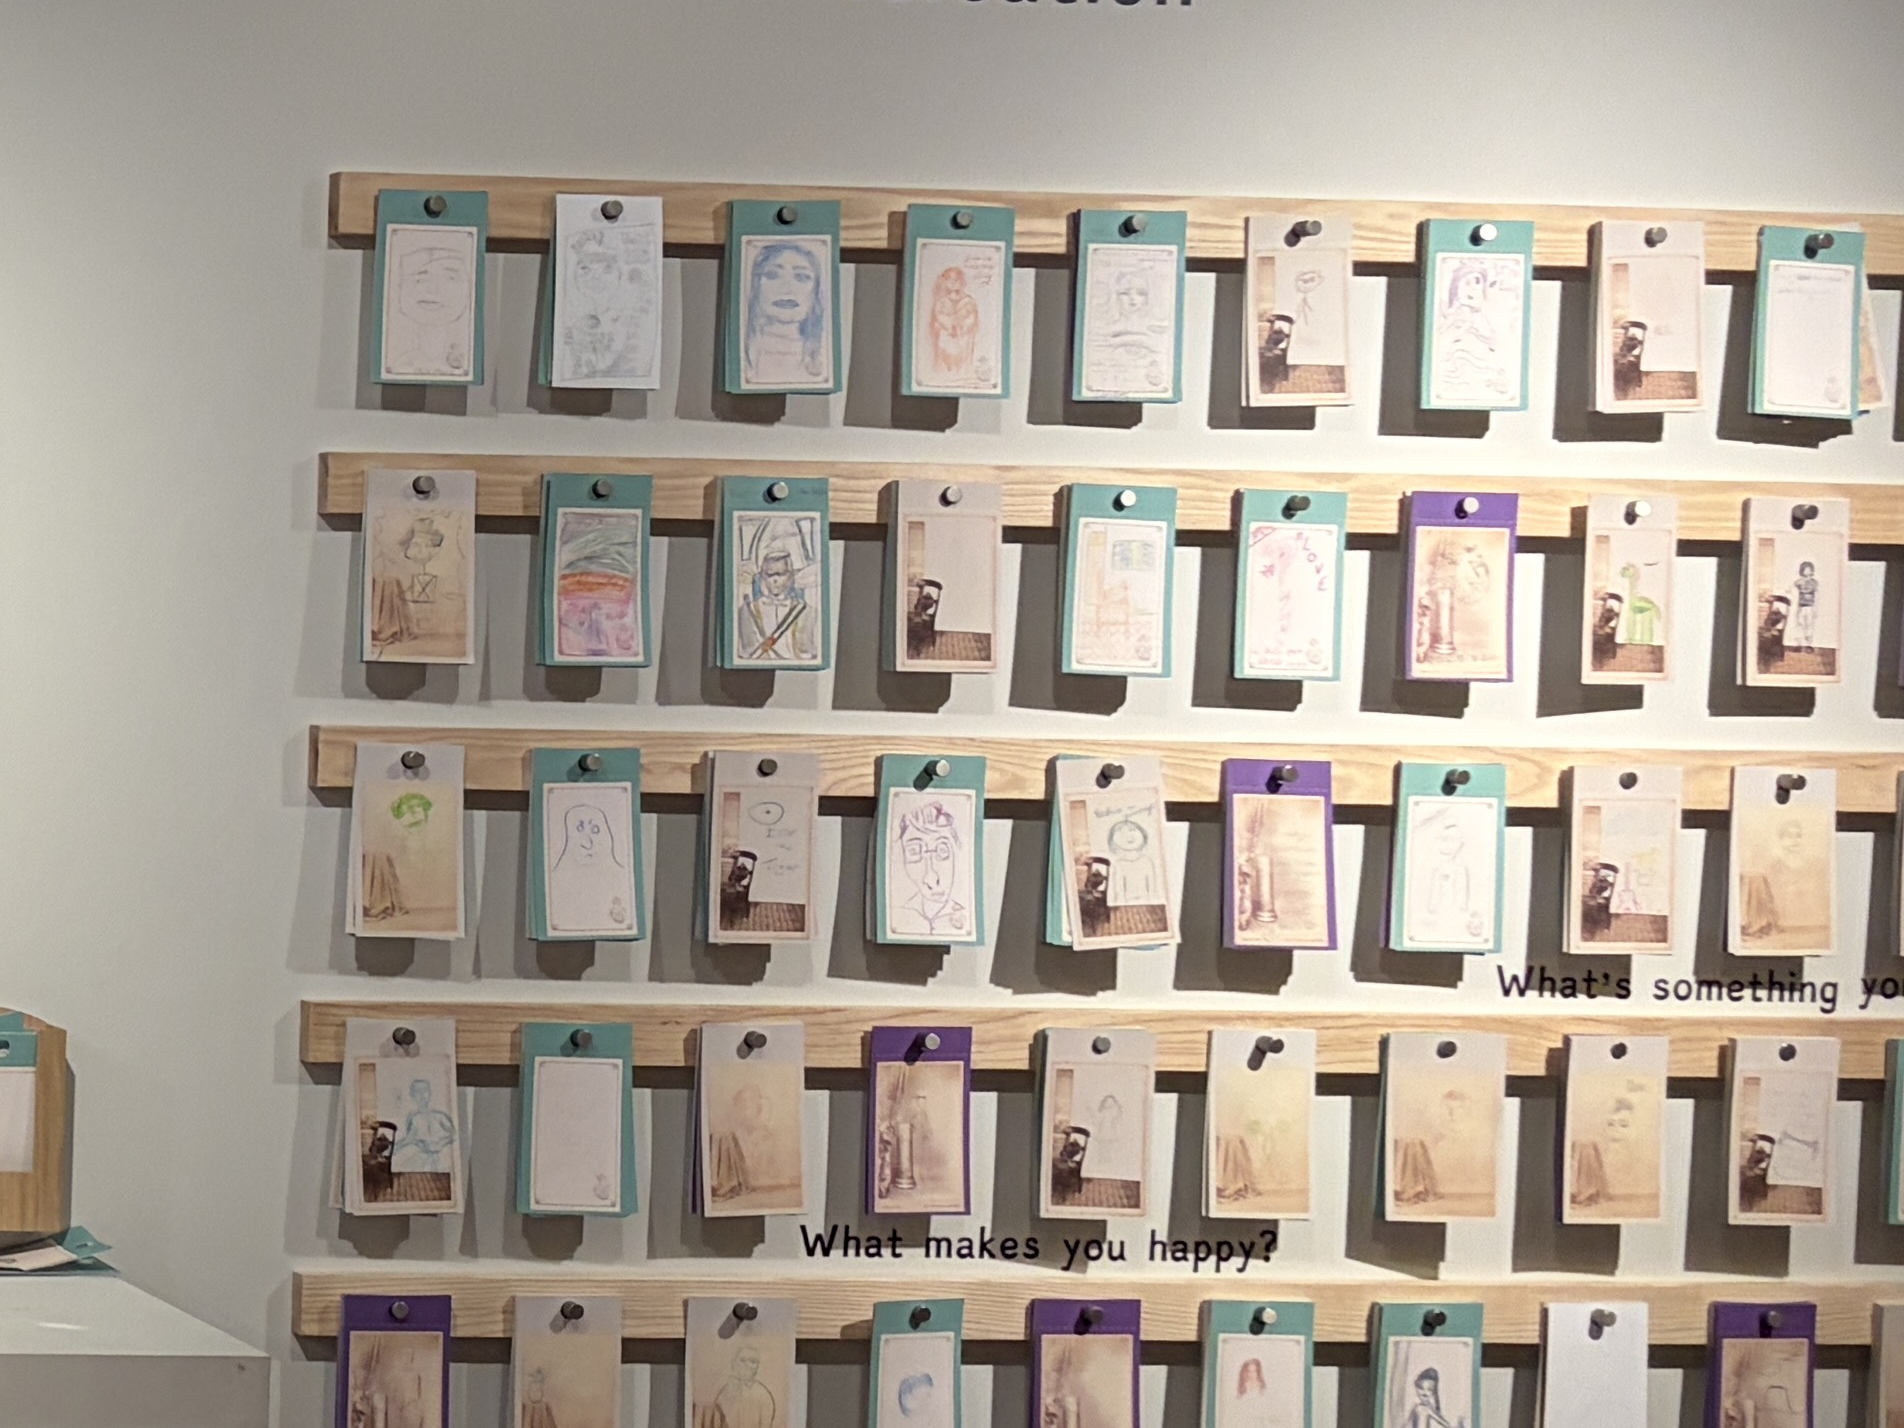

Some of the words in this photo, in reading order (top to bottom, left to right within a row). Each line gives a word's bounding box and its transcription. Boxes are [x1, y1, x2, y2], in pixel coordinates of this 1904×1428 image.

[1496, 964, 1632, 999] What's
[1653, 970, 1839, 1013] something
[1858, 977, 1904, 1010] yo
[800, 1224, 904, 1258] What
[924, 1226, 1040, 1261] makes
[1061, 1238, 1127, 1272] you
[1149, 1229, 1278, 1273] happy?
